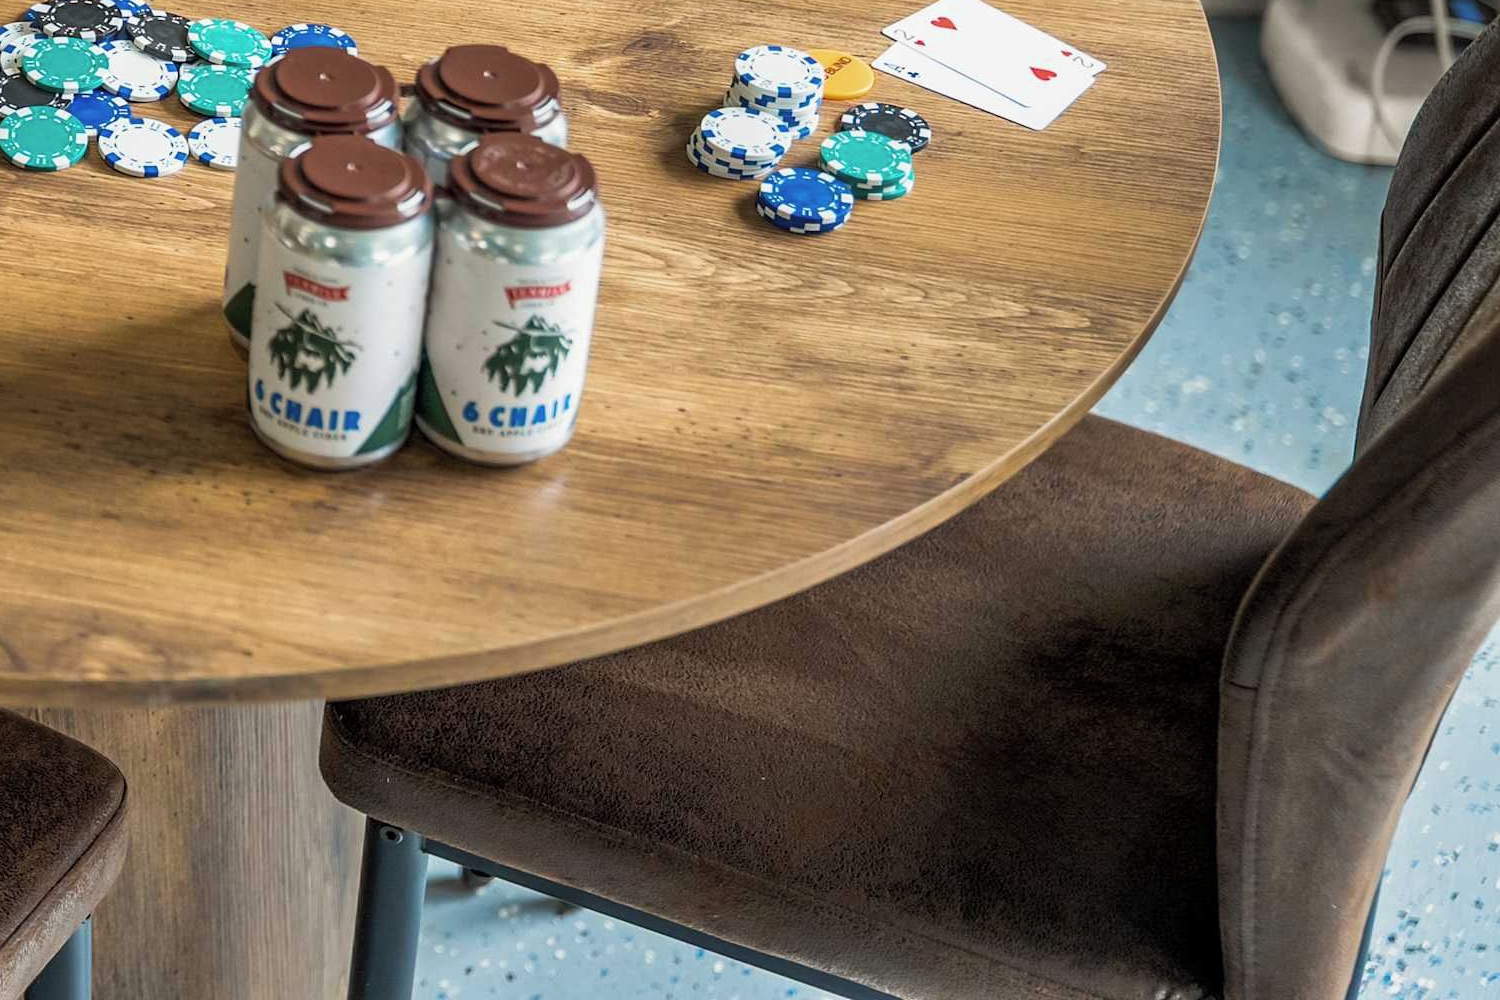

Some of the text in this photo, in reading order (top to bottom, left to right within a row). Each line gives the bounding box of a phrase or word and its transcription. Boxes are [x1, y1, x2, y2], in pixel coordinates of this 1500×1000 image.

[894, 29, 915, 41] 2
[824, 56, 852, 75] BLIND
[1072, 55, 1094, 69] 2
[269, 391, 361, 431] CHAIR
[463, 401, 479, 422] 6
